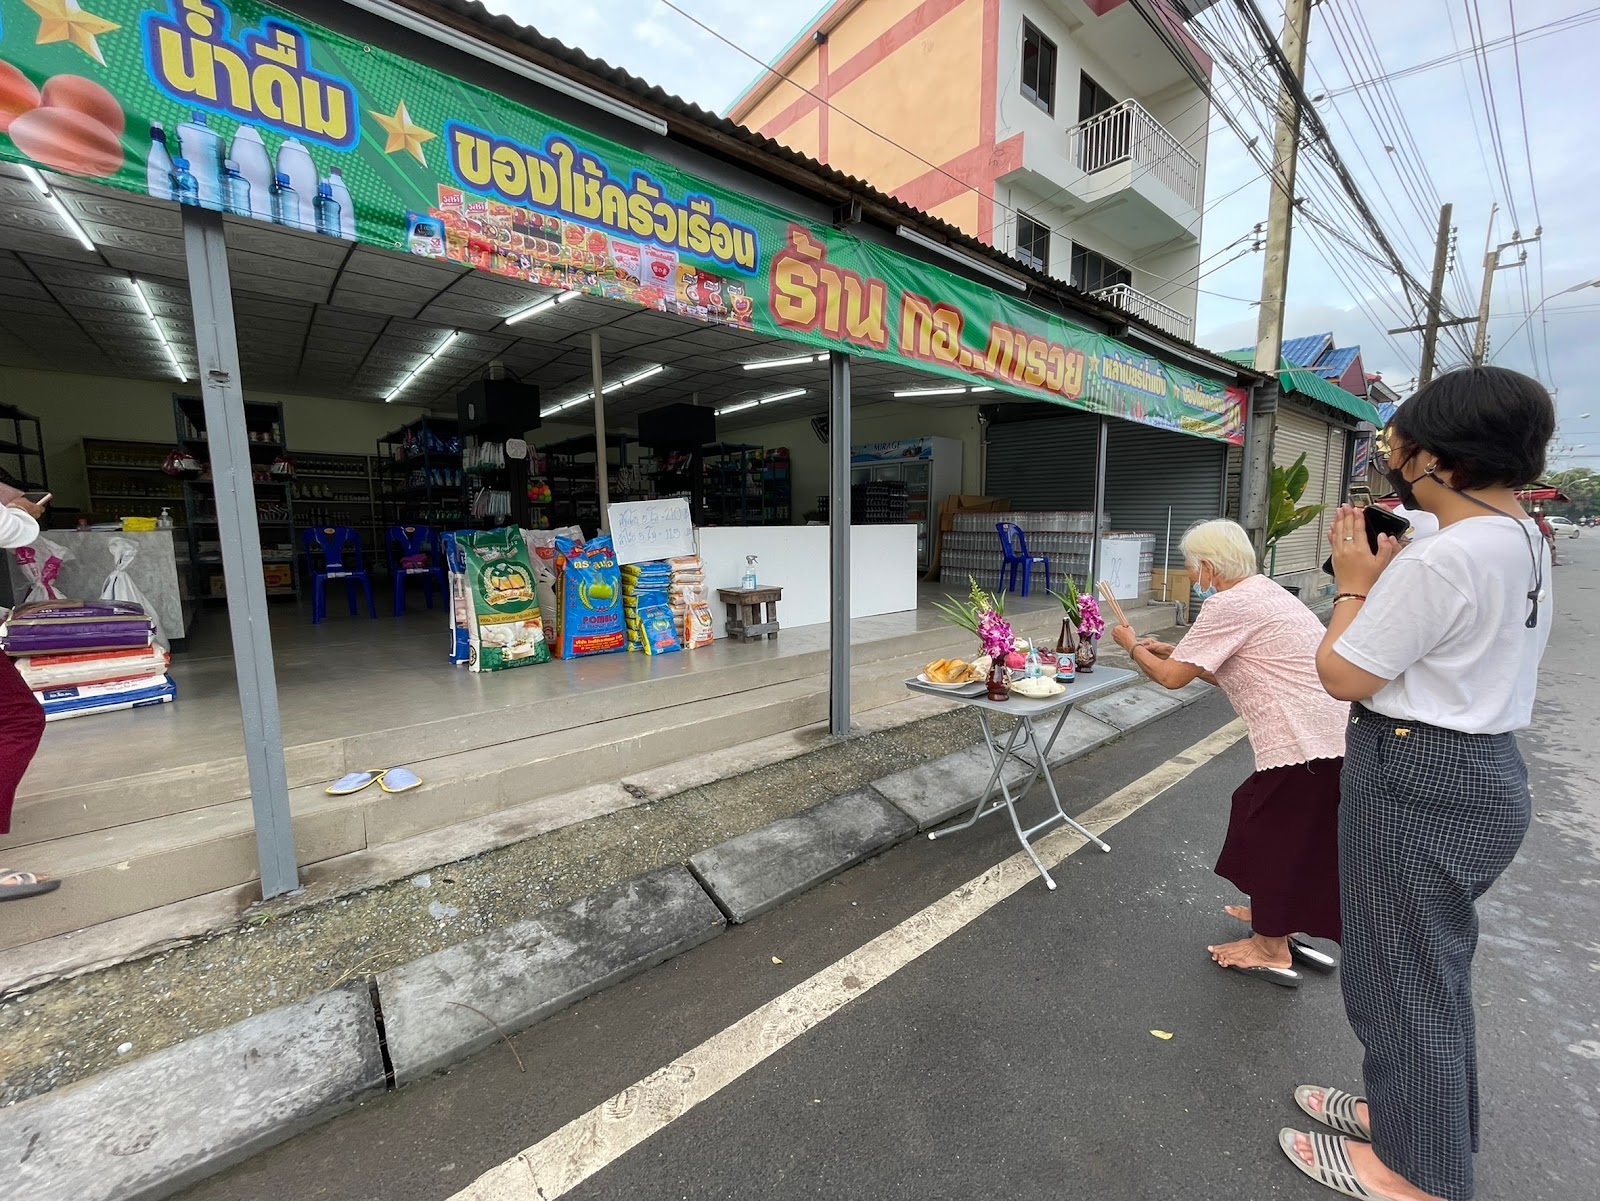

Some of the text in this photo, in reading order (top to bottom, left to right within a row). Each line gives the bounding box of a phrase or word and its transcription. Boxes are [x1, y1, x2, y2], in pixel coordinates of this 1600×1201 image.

[455, 131, 754, 268] ของใช้ครัวเรือน
[775, 230, 885, 344] ร้าน
[874, 440, 902, 451] MIRAGE
